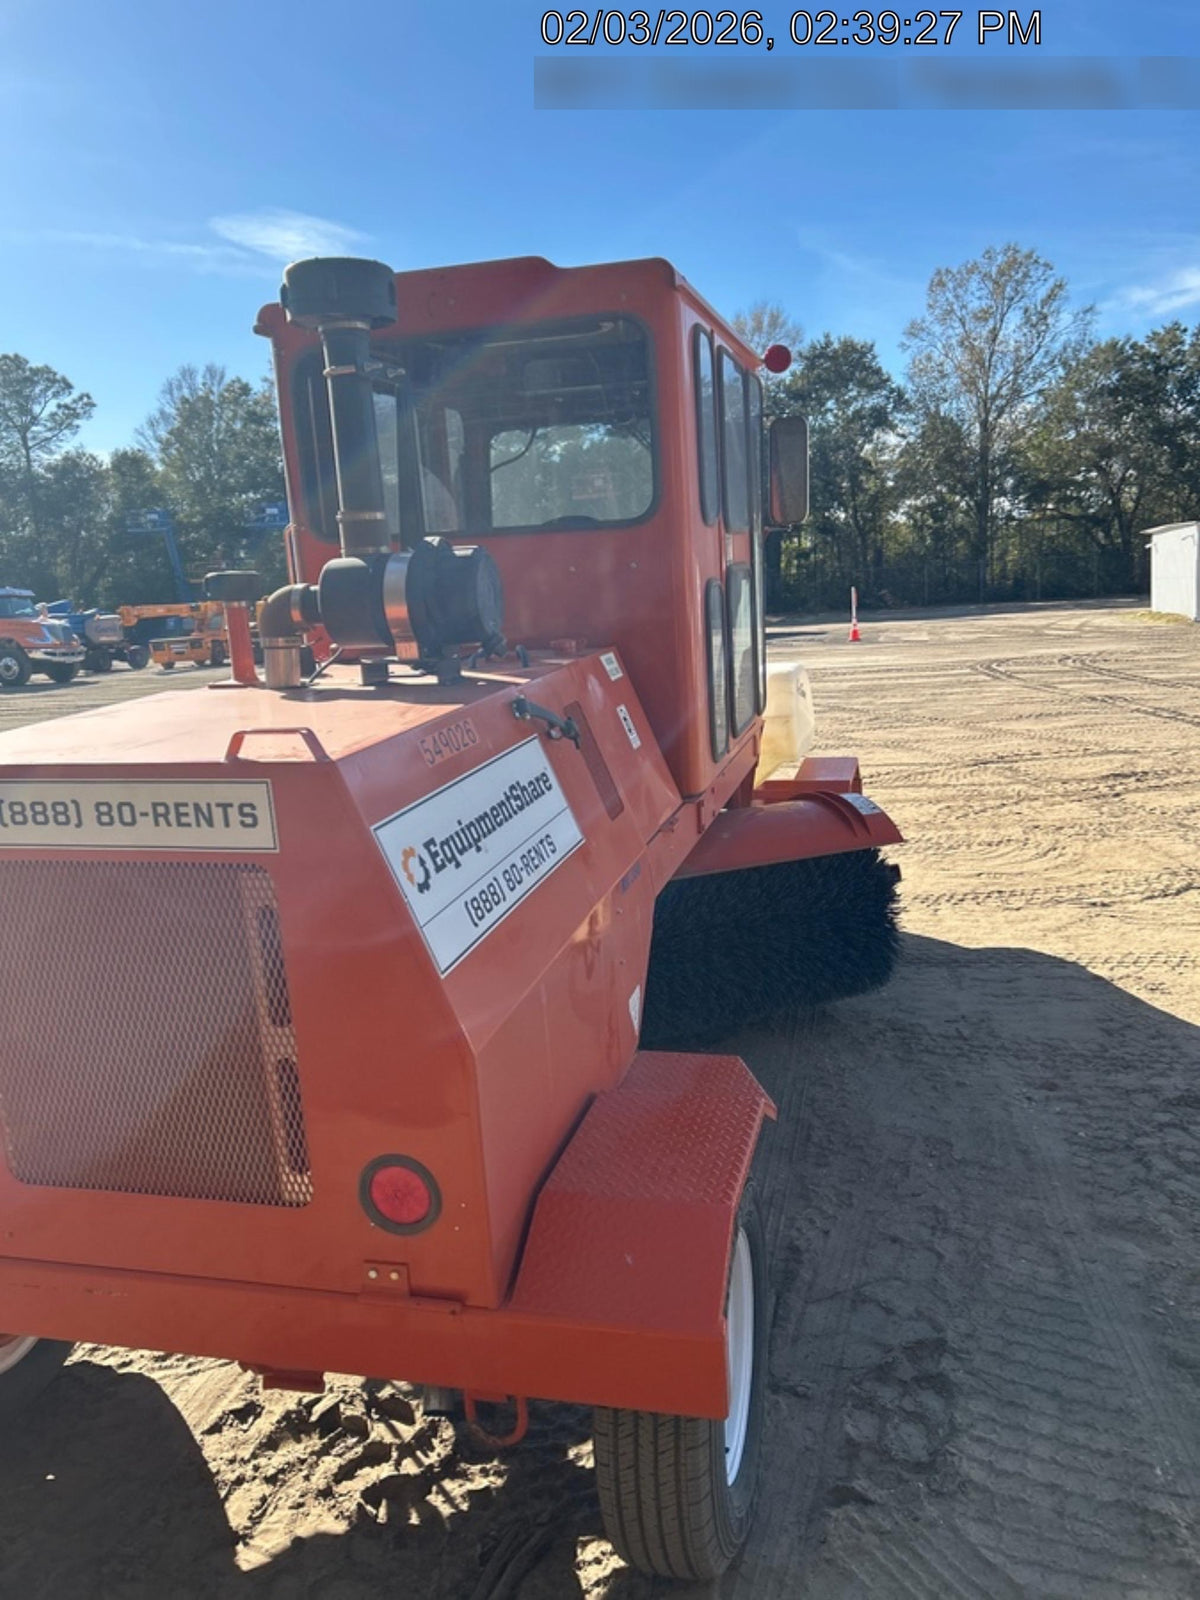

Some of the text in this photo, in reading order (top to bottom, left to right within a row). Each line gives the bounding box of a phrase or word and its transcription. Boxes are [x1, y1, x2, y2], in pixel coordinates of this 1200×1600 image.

[419, 719, 478, 765] 549026
[0, 799, 259, 828] (888) 80-RENTS
[422, 770, 553, 874] EquipmentShare
[464, 876, 507, 928] (888)
[502, 833, 557, 892] 80-RENTS
